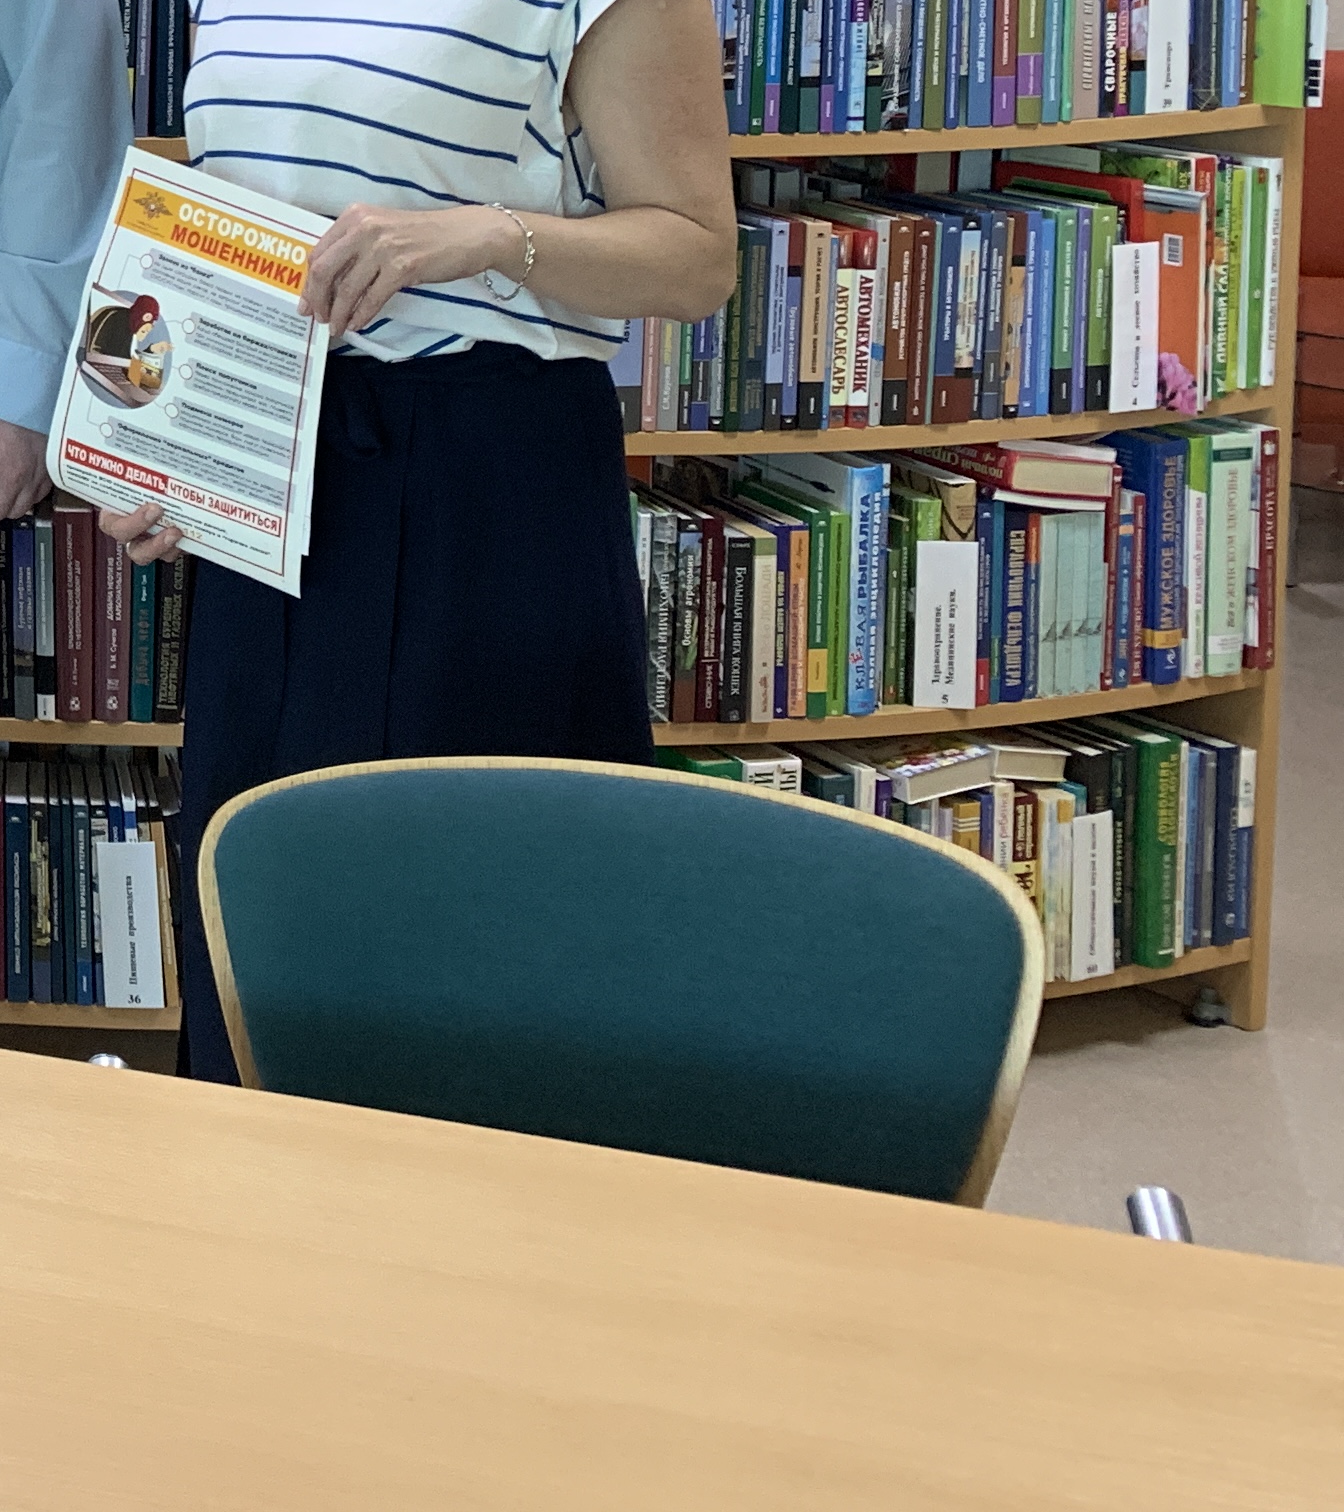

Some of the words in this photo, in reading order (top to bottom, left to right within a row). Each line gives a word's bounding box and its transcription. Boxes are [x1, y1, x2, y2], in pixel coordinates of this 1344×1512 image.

[170, 224, 303, 289] МОШЕННИКИ
[179, 203, 306, 265] ОСТОРОЖНО
[832, 284, 849, 395] АВТОСЛЕСАРЬ
[852, 274, 874, 394] АВТОМЕХАНИК
[67, 444, 87, 461] ЧТО
[89, 453, 124, 476] НУЖНО
[170, 480, 205, 504] ЧТОБЫ
[208, 496, 277, 532] ЗАЩИТИТЬСЯ
[126, 875, 137, 936] производства
[127, 995, 141, 1005] 36
